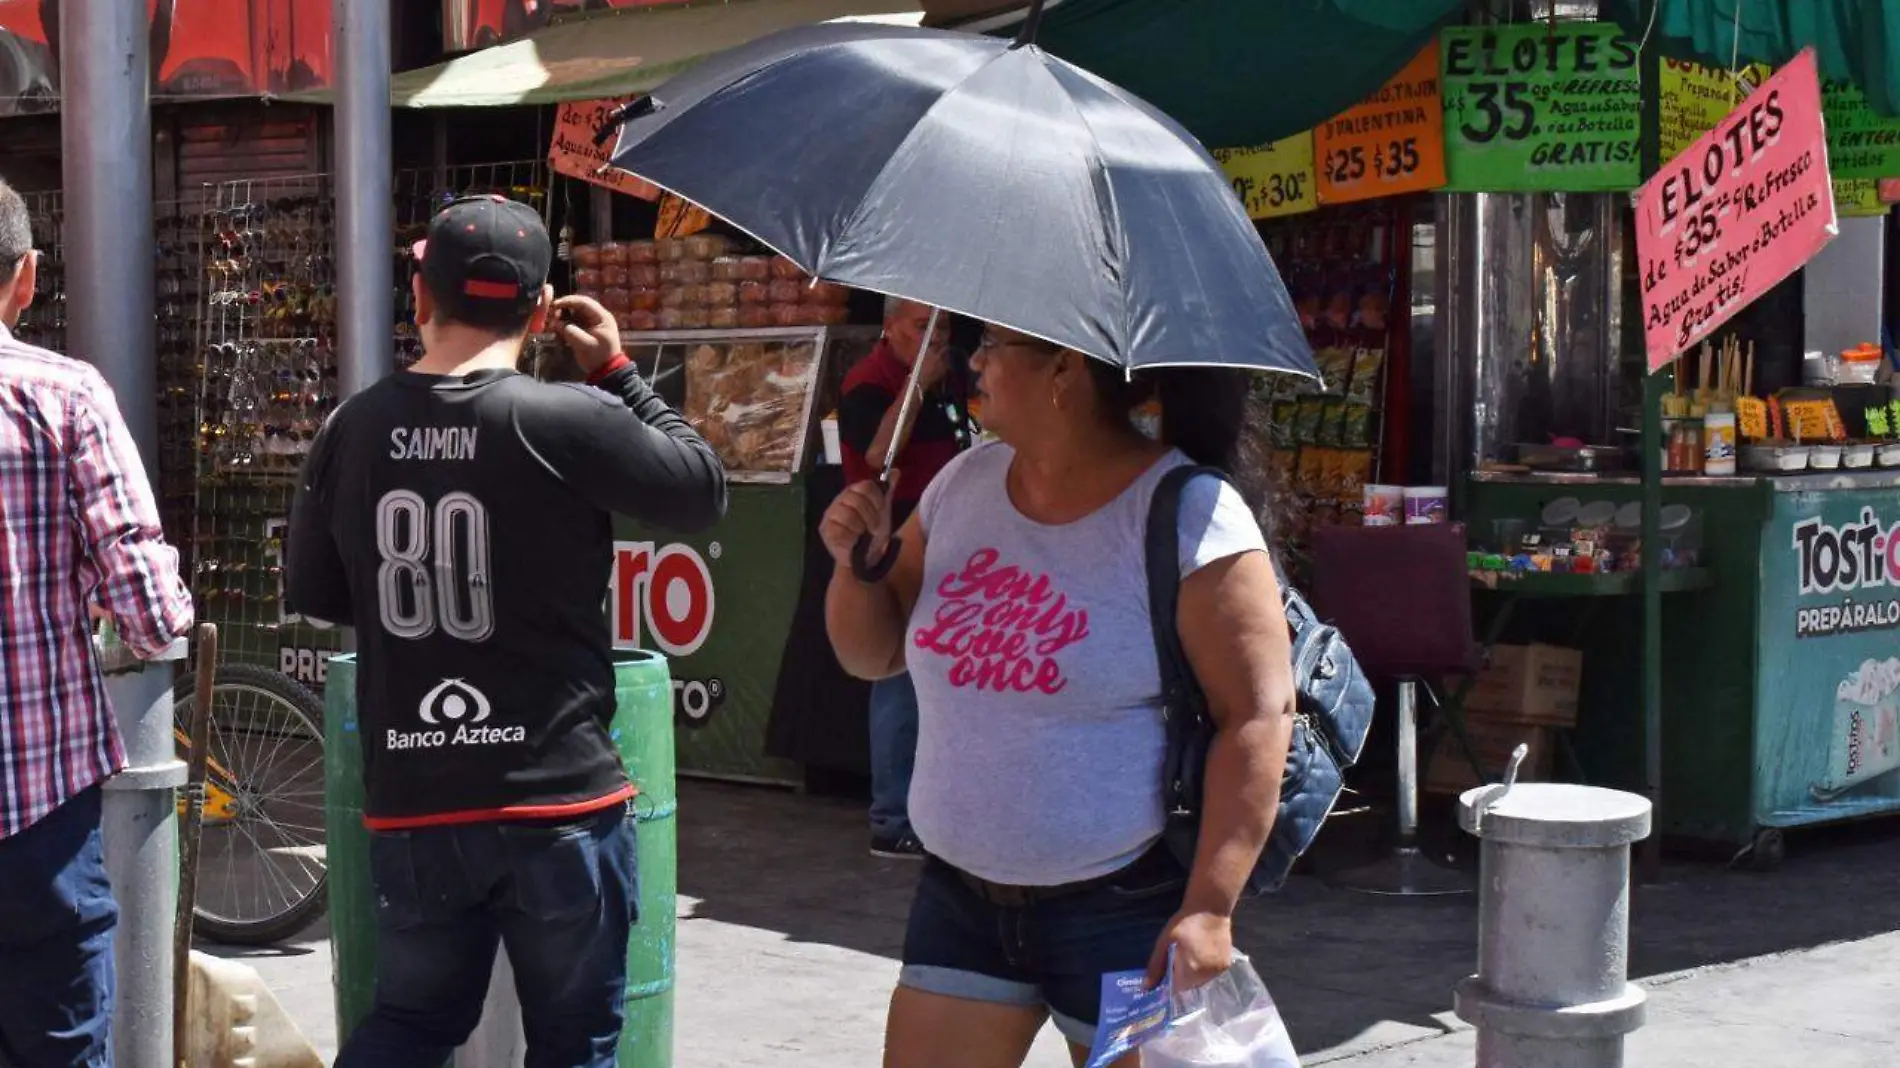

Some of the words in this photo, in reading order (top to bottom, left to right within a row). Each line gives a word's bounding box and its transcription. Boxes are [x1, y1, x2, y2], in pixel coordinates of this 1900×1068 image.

[1447, 34, 1637, 76] ELOTES
[1335, 106, 1428, 138] VALENTINA
[1324, 146, 1365, 184] $25
[1374, 137, 1420, 178] $35
[1662, 90, 1784, 224] ELOTES
[1645, 260, 1667, 293] de
[1648, 288, 1690, 331] Agua
[1707, 243, 1749, 284] Sabor
[1761, 192, 1818, 248] Botella
[389, 426, 478, 460] SAIMON
[376, 488, 495, 643] 80
[937, 547, 1054, 605] You
[914, 599, 1031, 661] Love
[982, 593, 1090, 655] only
[1798, 598, 1900, 633] PREPÁRALO
[949, 657, 1068, 695] once
[387, 728, 446, 749] Banco
[452, 725, 526, 746] Azteca
